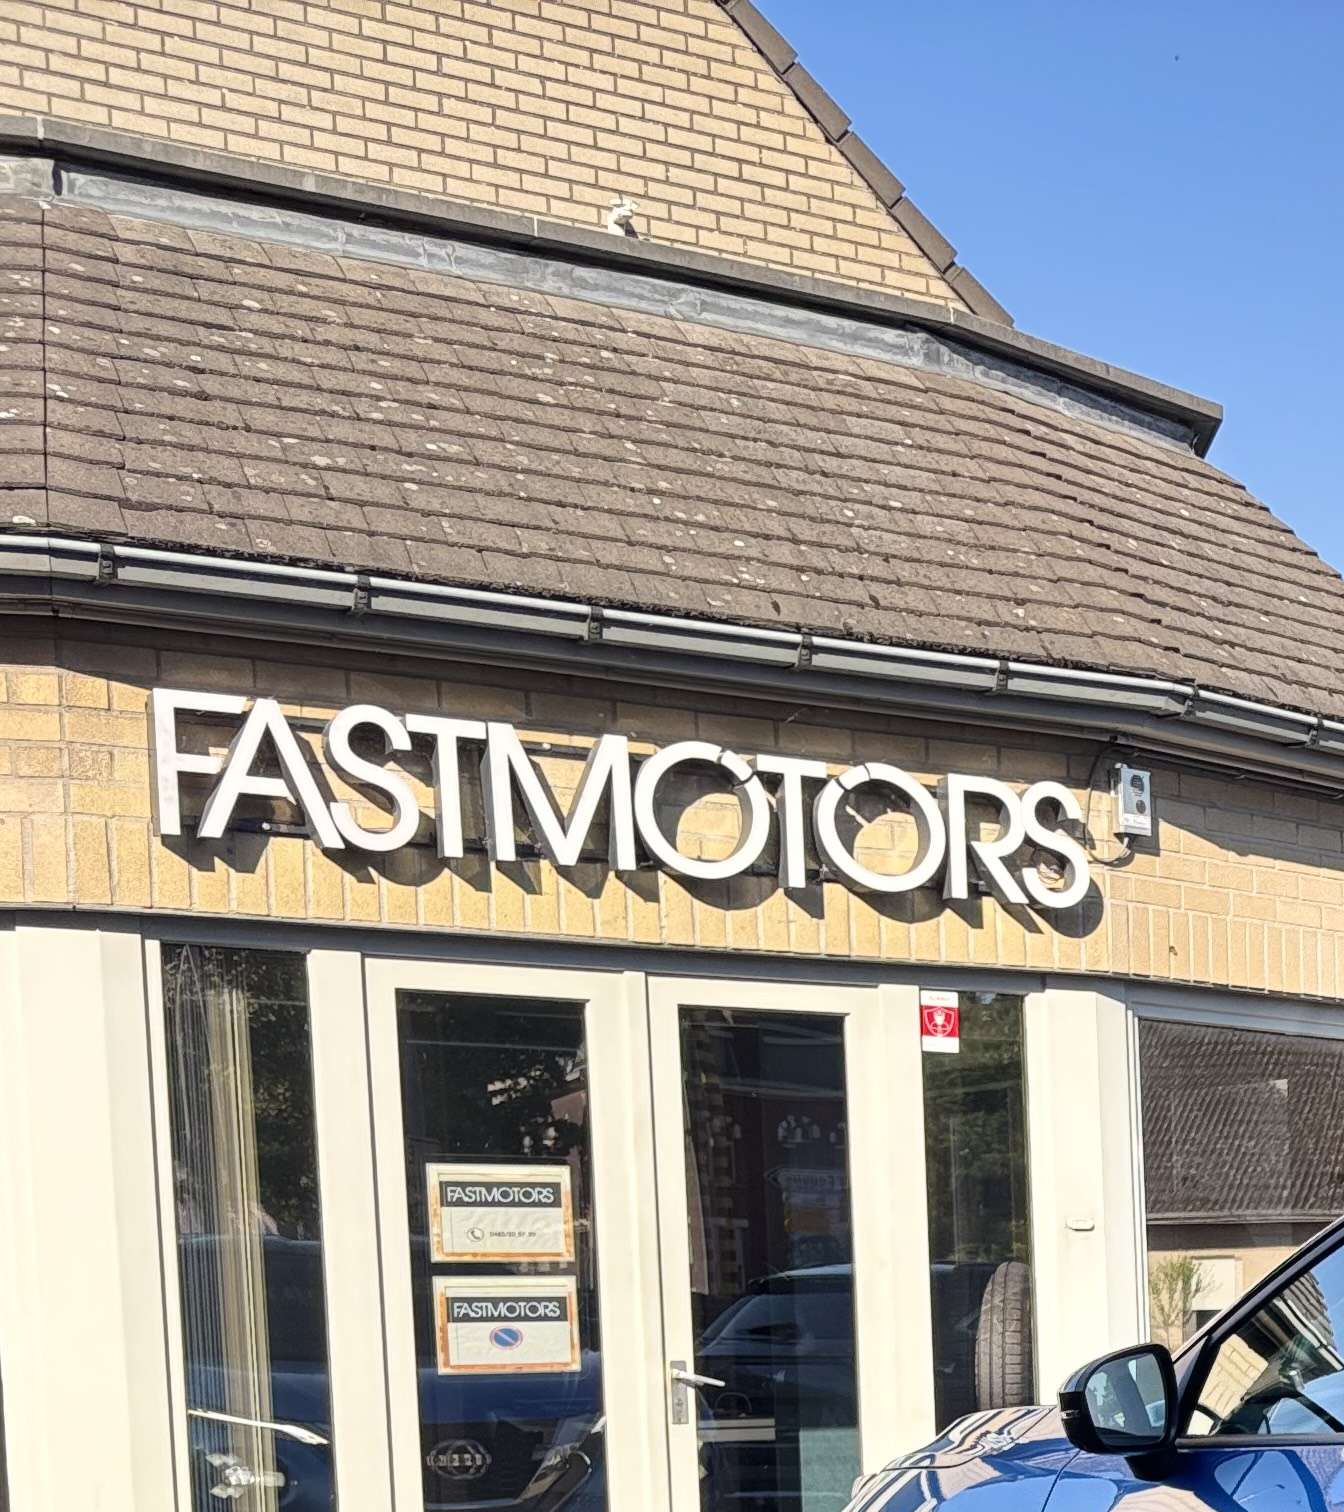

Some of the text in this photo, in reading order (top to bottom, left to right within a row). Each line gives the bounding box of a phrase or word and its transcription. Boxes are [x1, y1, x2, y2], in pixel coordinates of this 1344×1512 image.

[151, 687, 1091, 909] FASTMOTORS
[446, 1186, 554, 1204] FASTMOTORS
[453, 1301, 561, 1319] FASTMOTORS
